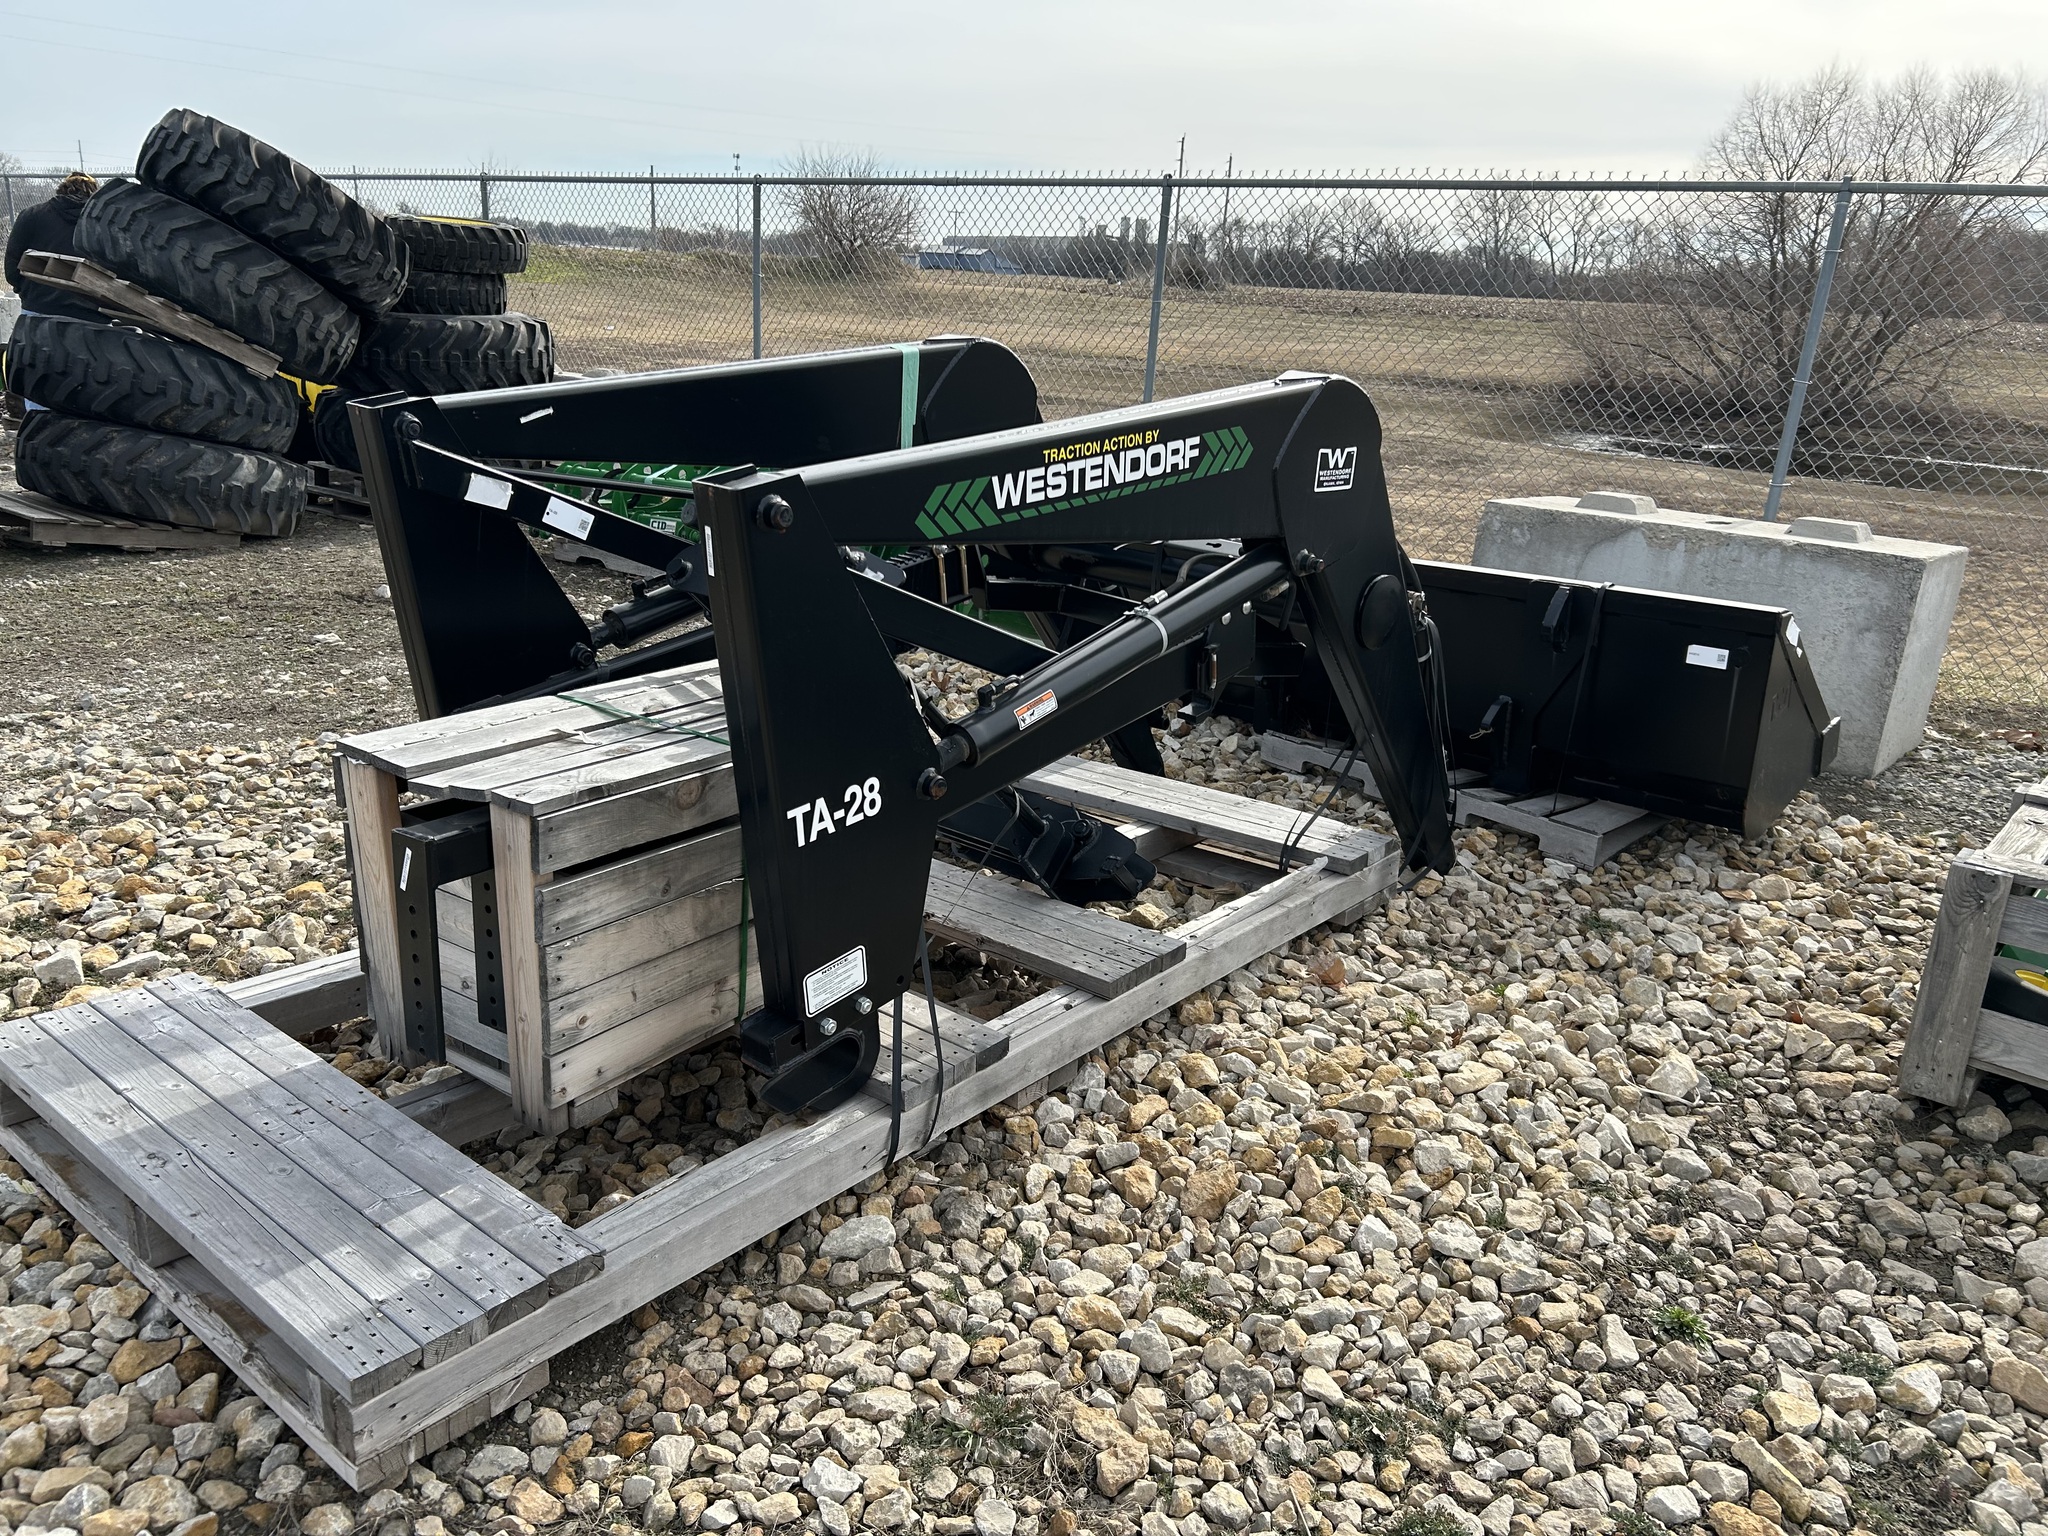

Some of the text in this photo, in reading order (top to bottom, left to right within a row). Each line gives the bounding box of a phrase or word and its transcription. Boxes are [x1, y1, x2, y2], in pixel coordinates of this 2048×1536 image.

[992, 435, 1200, 509] WESTENDORF
[1043, 429, 1160, 463] TRACTION ACTION BY
[786, 776, 882, 848] TA-28
[821, 957, 849, 975] NOTICE
